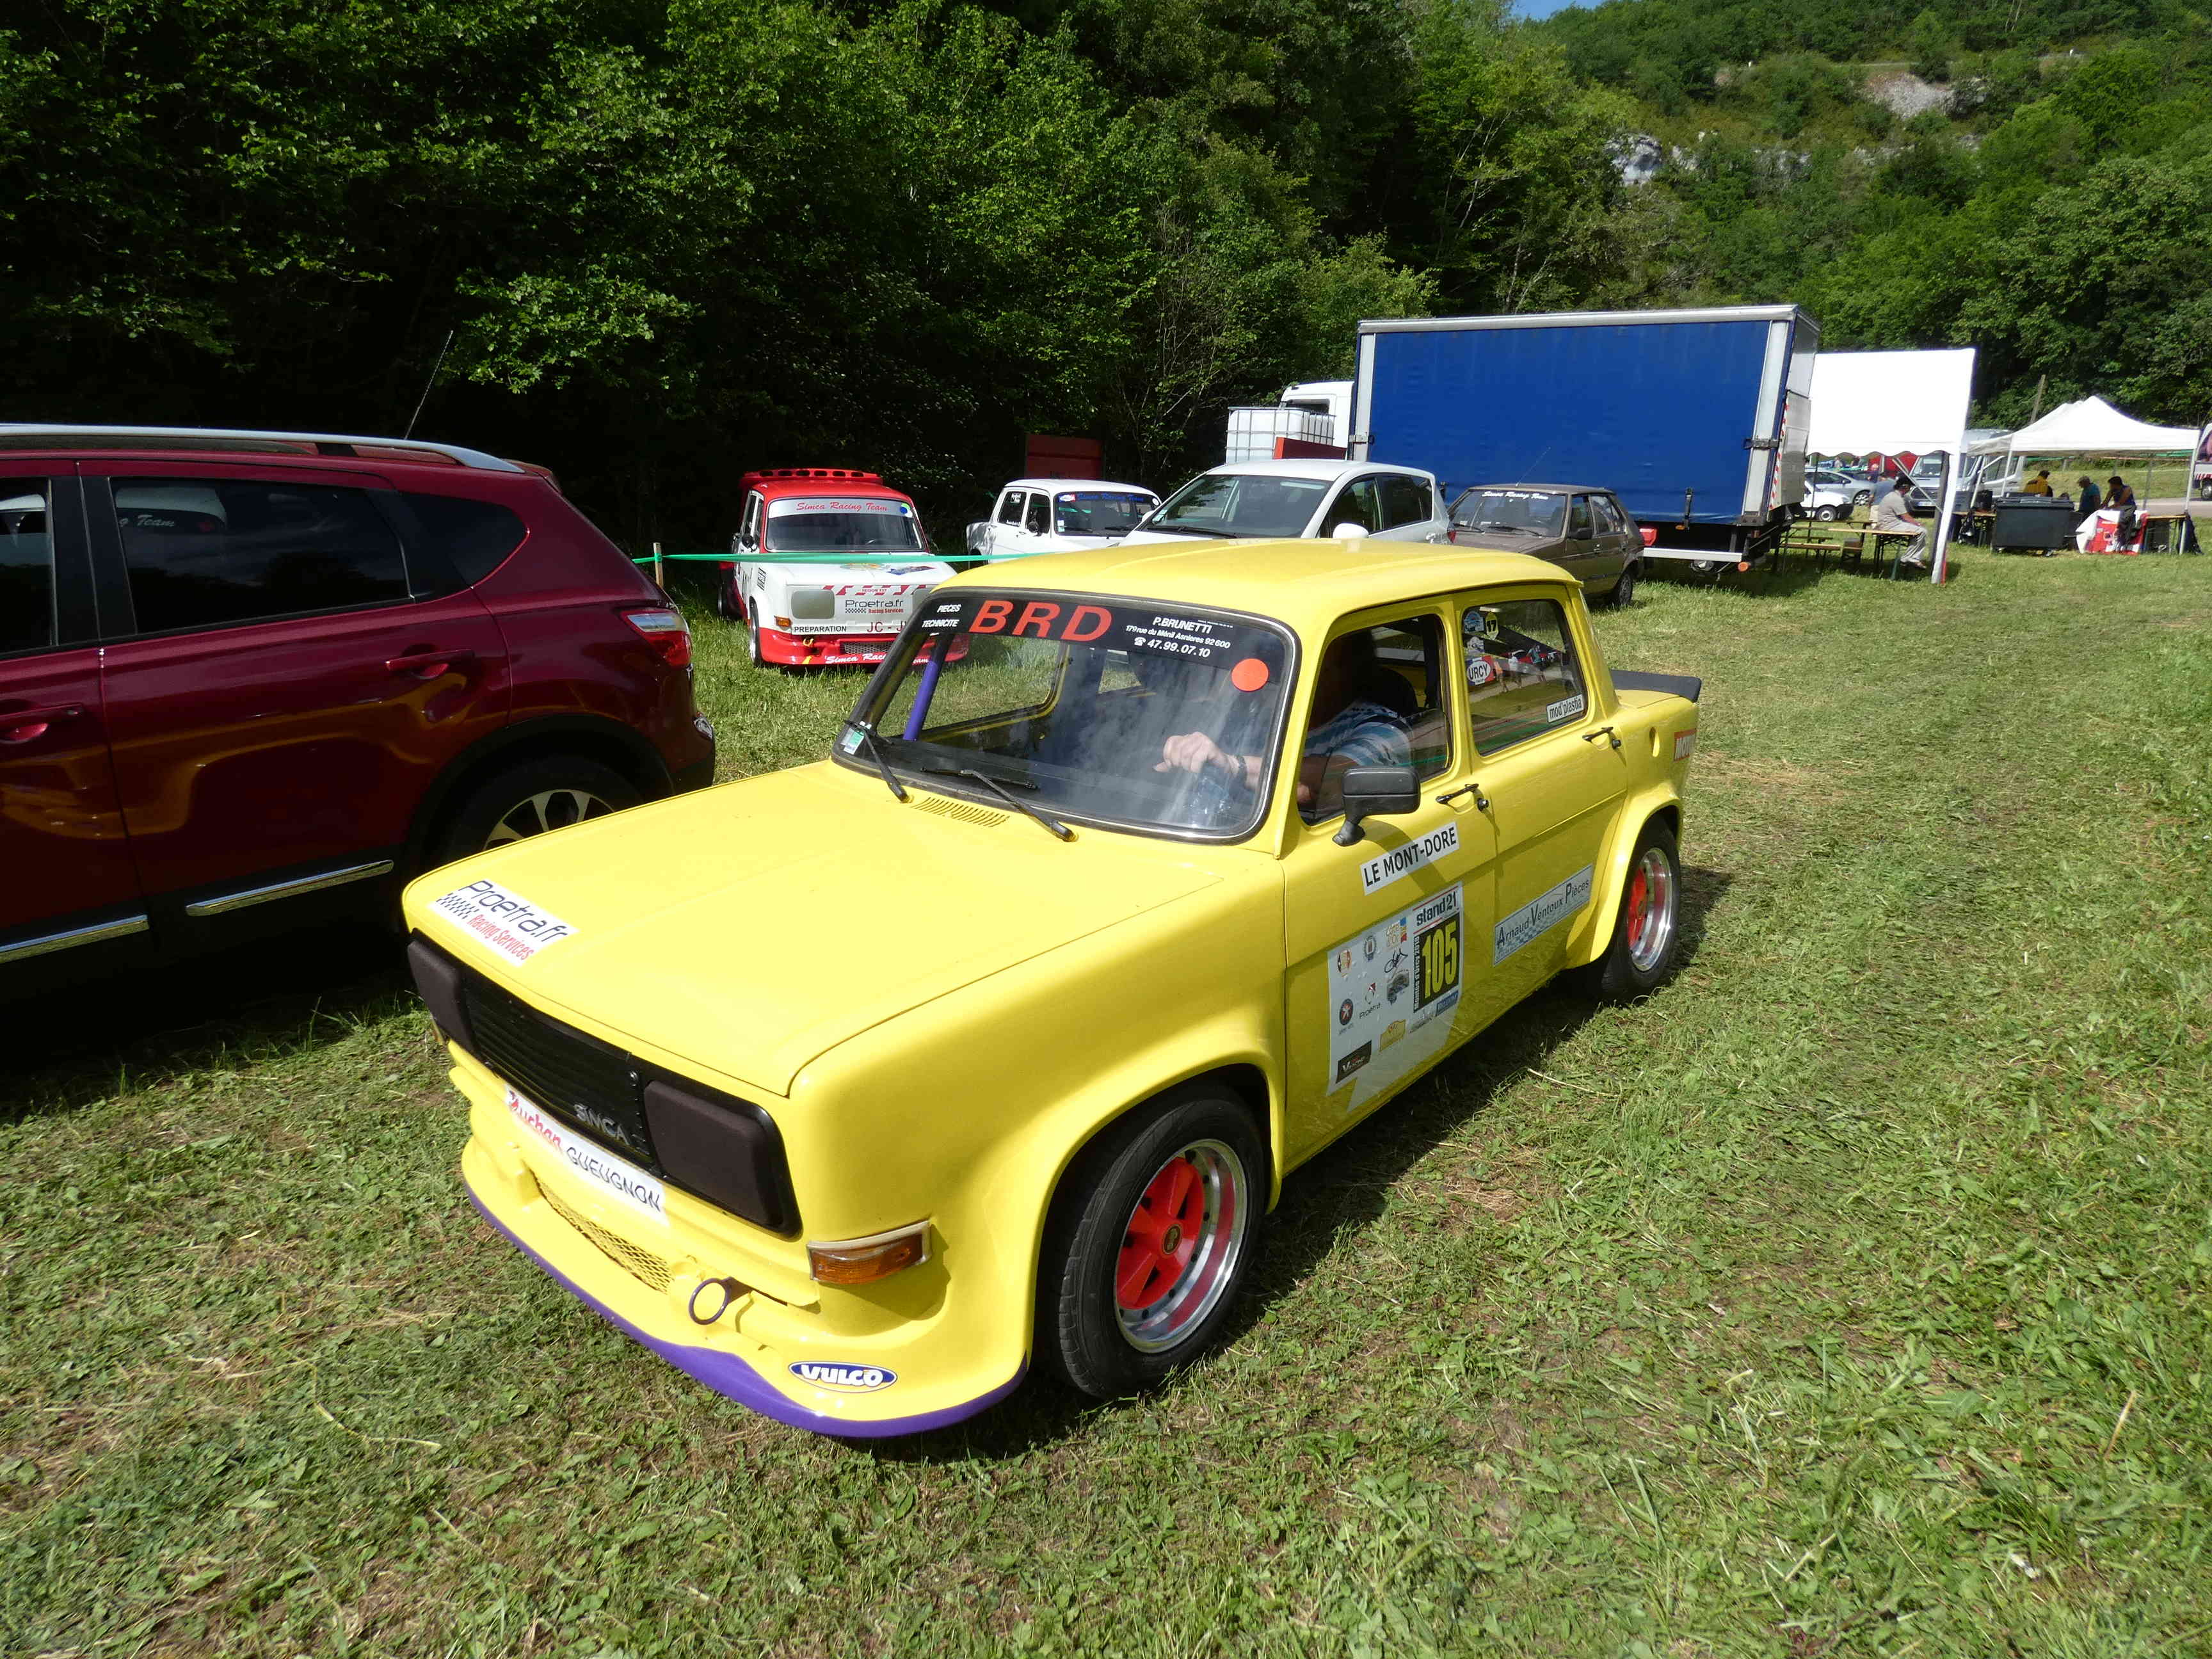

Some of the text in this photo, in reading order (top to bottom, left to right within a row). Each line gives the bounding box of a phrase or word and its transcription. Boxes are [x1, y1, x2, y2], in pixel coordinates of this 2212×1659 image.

[796, 501, 888, 511] Simca Racing Team
[137, 514, 175, 527] Team
[845, 599, 903, 607] Proetra.fr
[936, 604, 961, 613] PIECES
[867, 621, 883, 633] JC
[896, 620, 906, 632] J
[922, 619, 960, 628] TECHNICITE
[1153, 616, 1213, 634] P.BRUNETTI
[1486, 620, 1497, 632] 17
[1147, 639, 1211, 658] 47.99.07.10
[1204, 637, 1215, 645] 92
[862, 652, 886, 661] Raci
[1468, 663, 1487, 680] URCY
[1549, 696, 1582, 719] mod'plastia
[1364, 827, 1457, 886] LE MONT-DORE
[458, 880, 568, 942] Proetra.fr
[1416, 891, 1456, 926] stand21
[1496, 879, 1589, 949] Arnaud Ventoux Pièces
[467, 913, 534, 961] Racing Services
[1422, 920, 1457, 999] 105
[573, 1102, 630, 1146] SIMCA
[509, 1090, 661, 1212] Auchan GUEUGNON
[801, 1364, 884, 1388] VULCO
